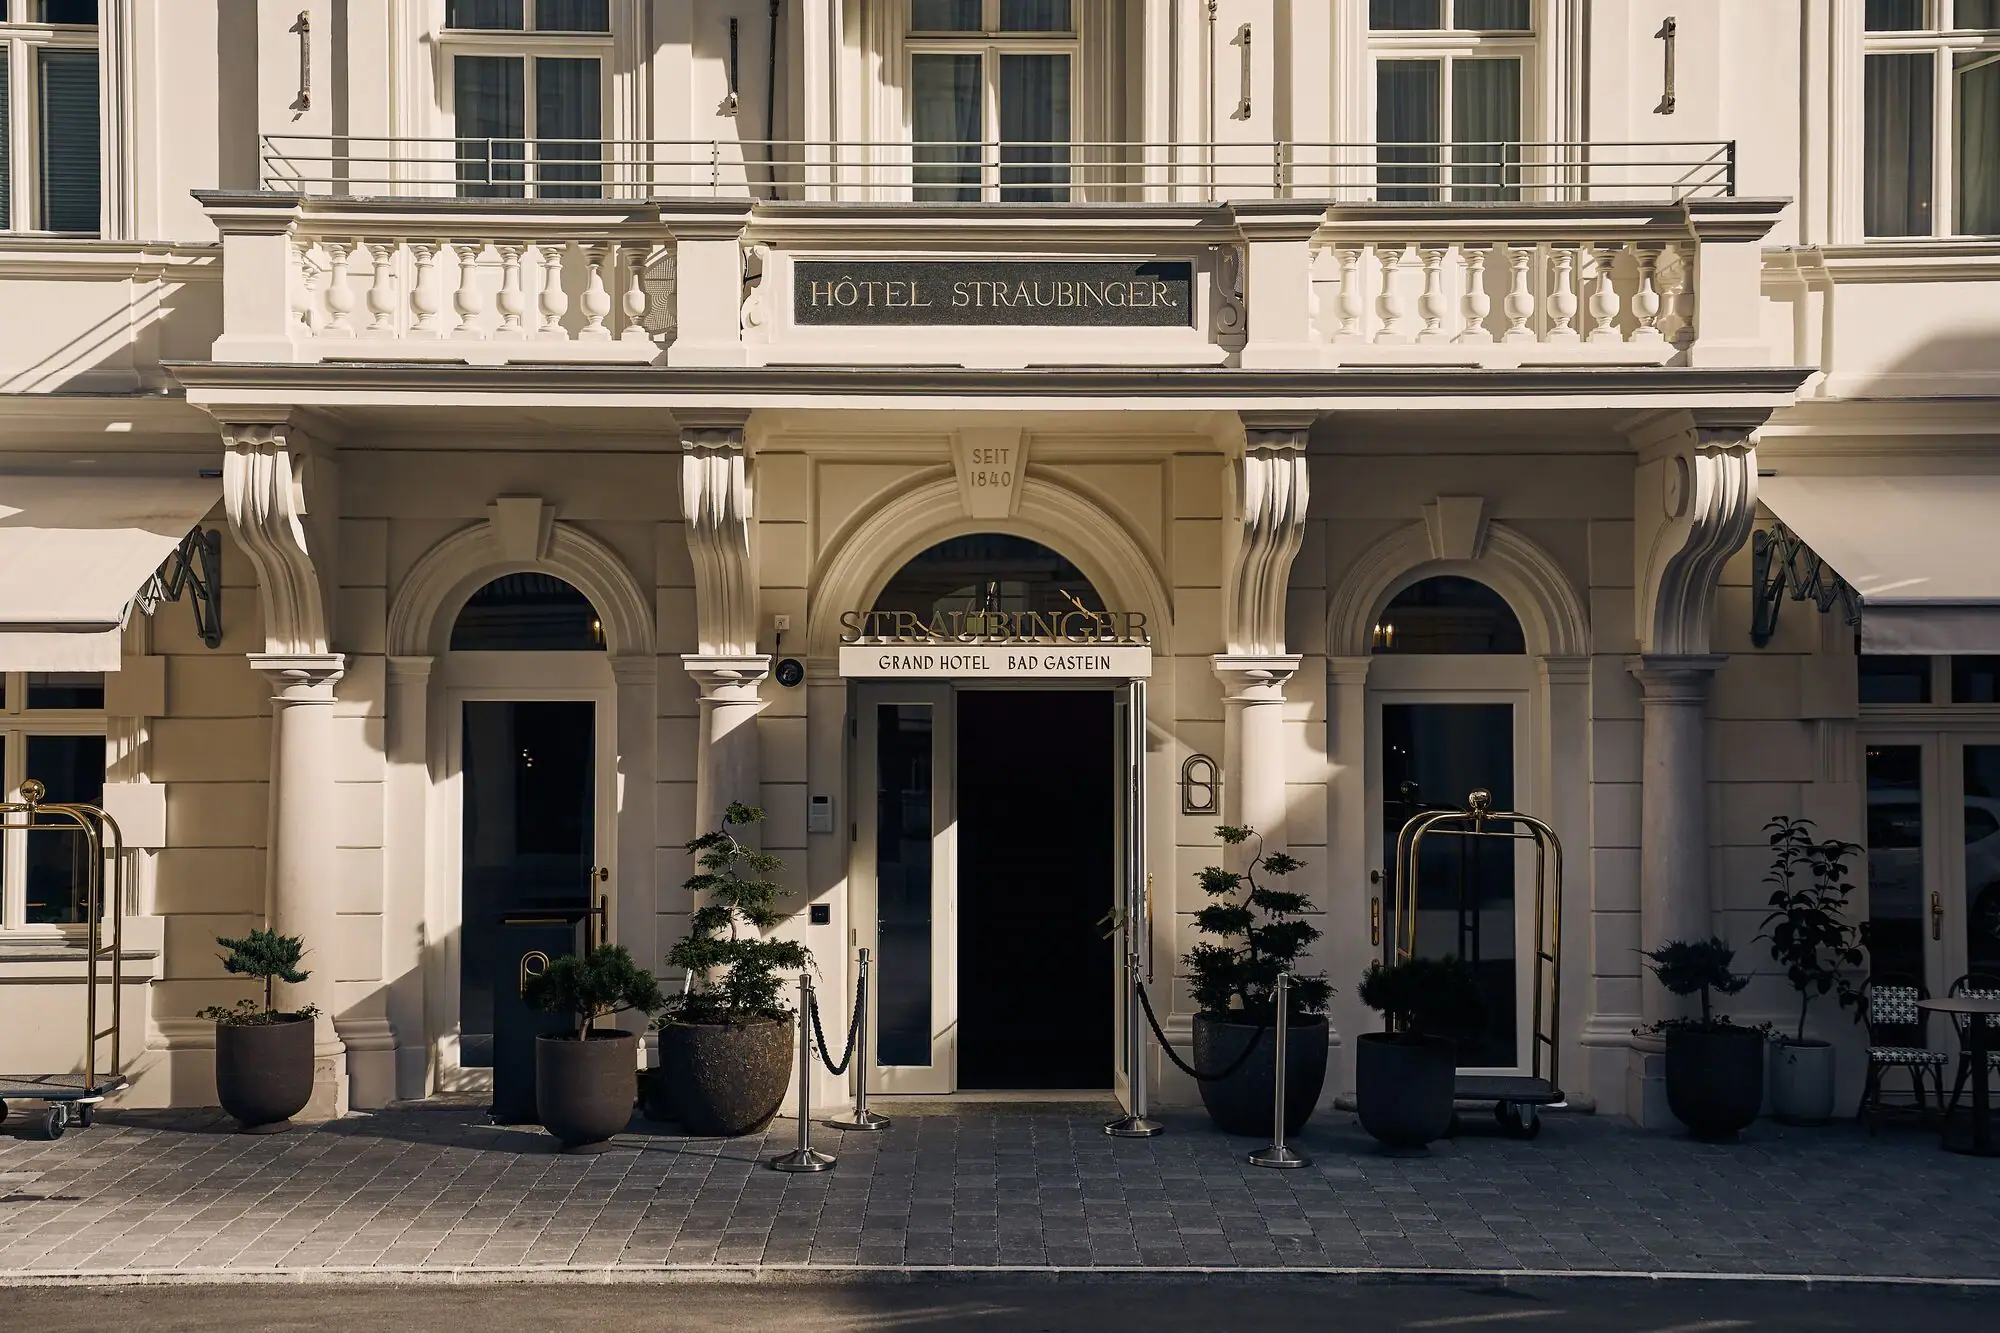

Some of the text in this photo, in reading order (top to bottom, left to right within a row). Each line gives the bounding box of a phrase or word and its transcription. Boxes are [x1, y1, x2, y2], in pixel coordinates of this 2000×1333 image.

[810, 275, 1178, 307] HÔTEL STRAUBINGER.
[972, 448, 1010, 465] SEIT
[970, 471, 1012, 487] 1840
[839, 610, 1150, 643] STRAUBINGER
[878, 655, 1111, 671] GRAND HOTEL BAD GASTEIN
